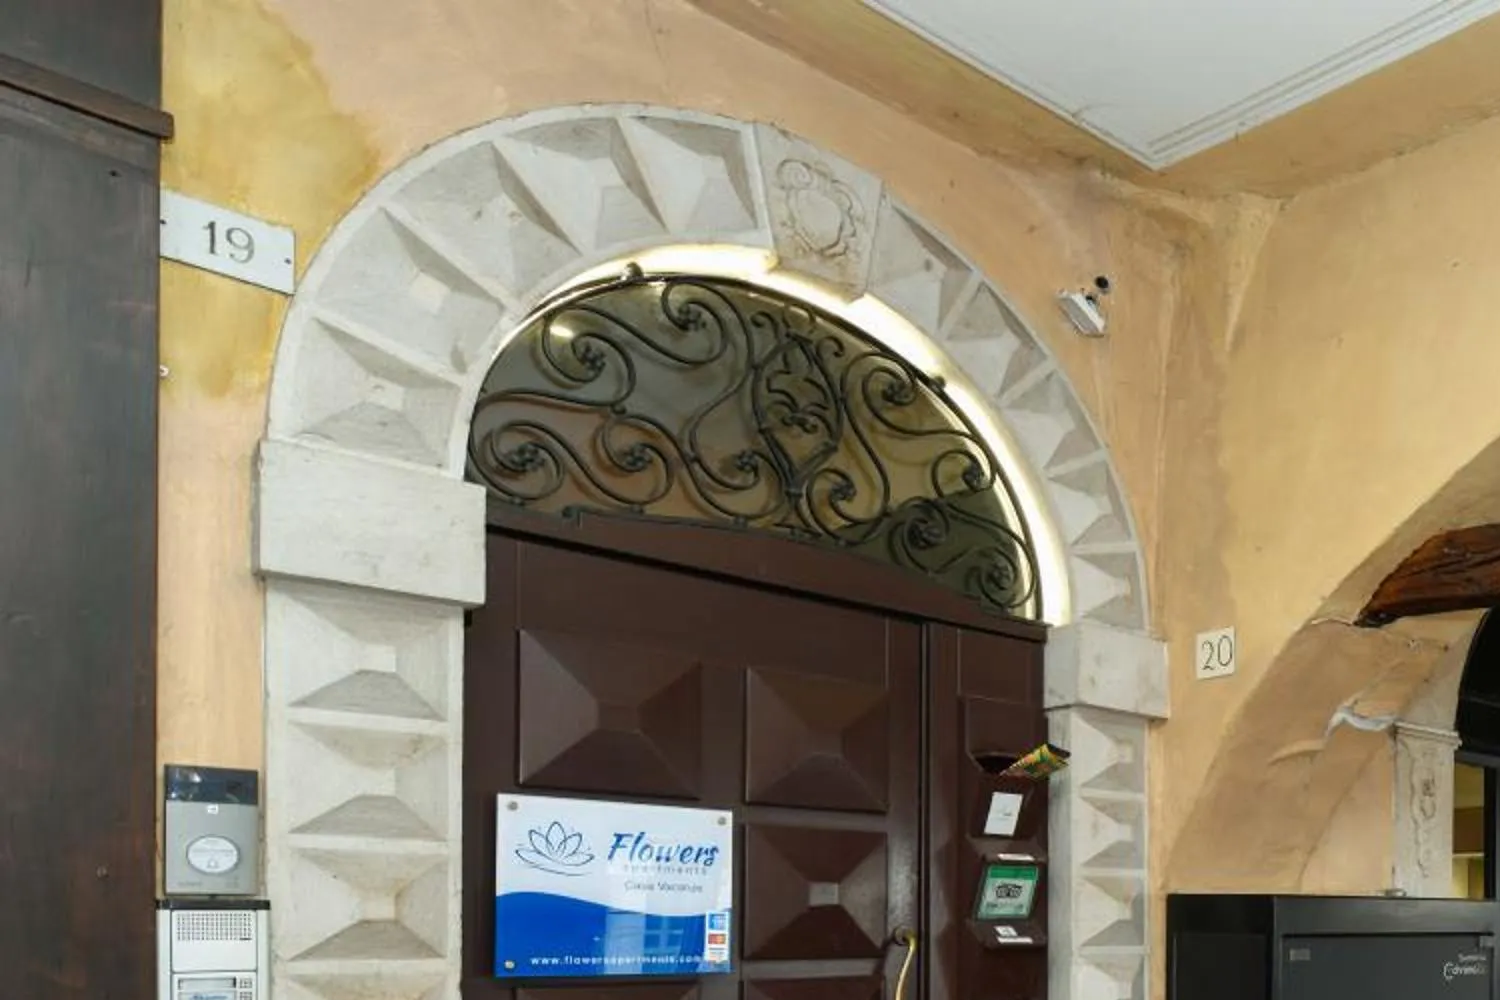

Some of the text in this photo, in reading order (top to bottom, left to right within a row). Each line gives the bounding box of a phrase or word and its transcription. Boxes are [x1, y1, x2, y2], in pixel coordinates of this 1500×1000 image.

[202, 220, 255, 264] 19
[1201, 634, 1234, 671] 20
[607, 831, 720, 867] Flowers
